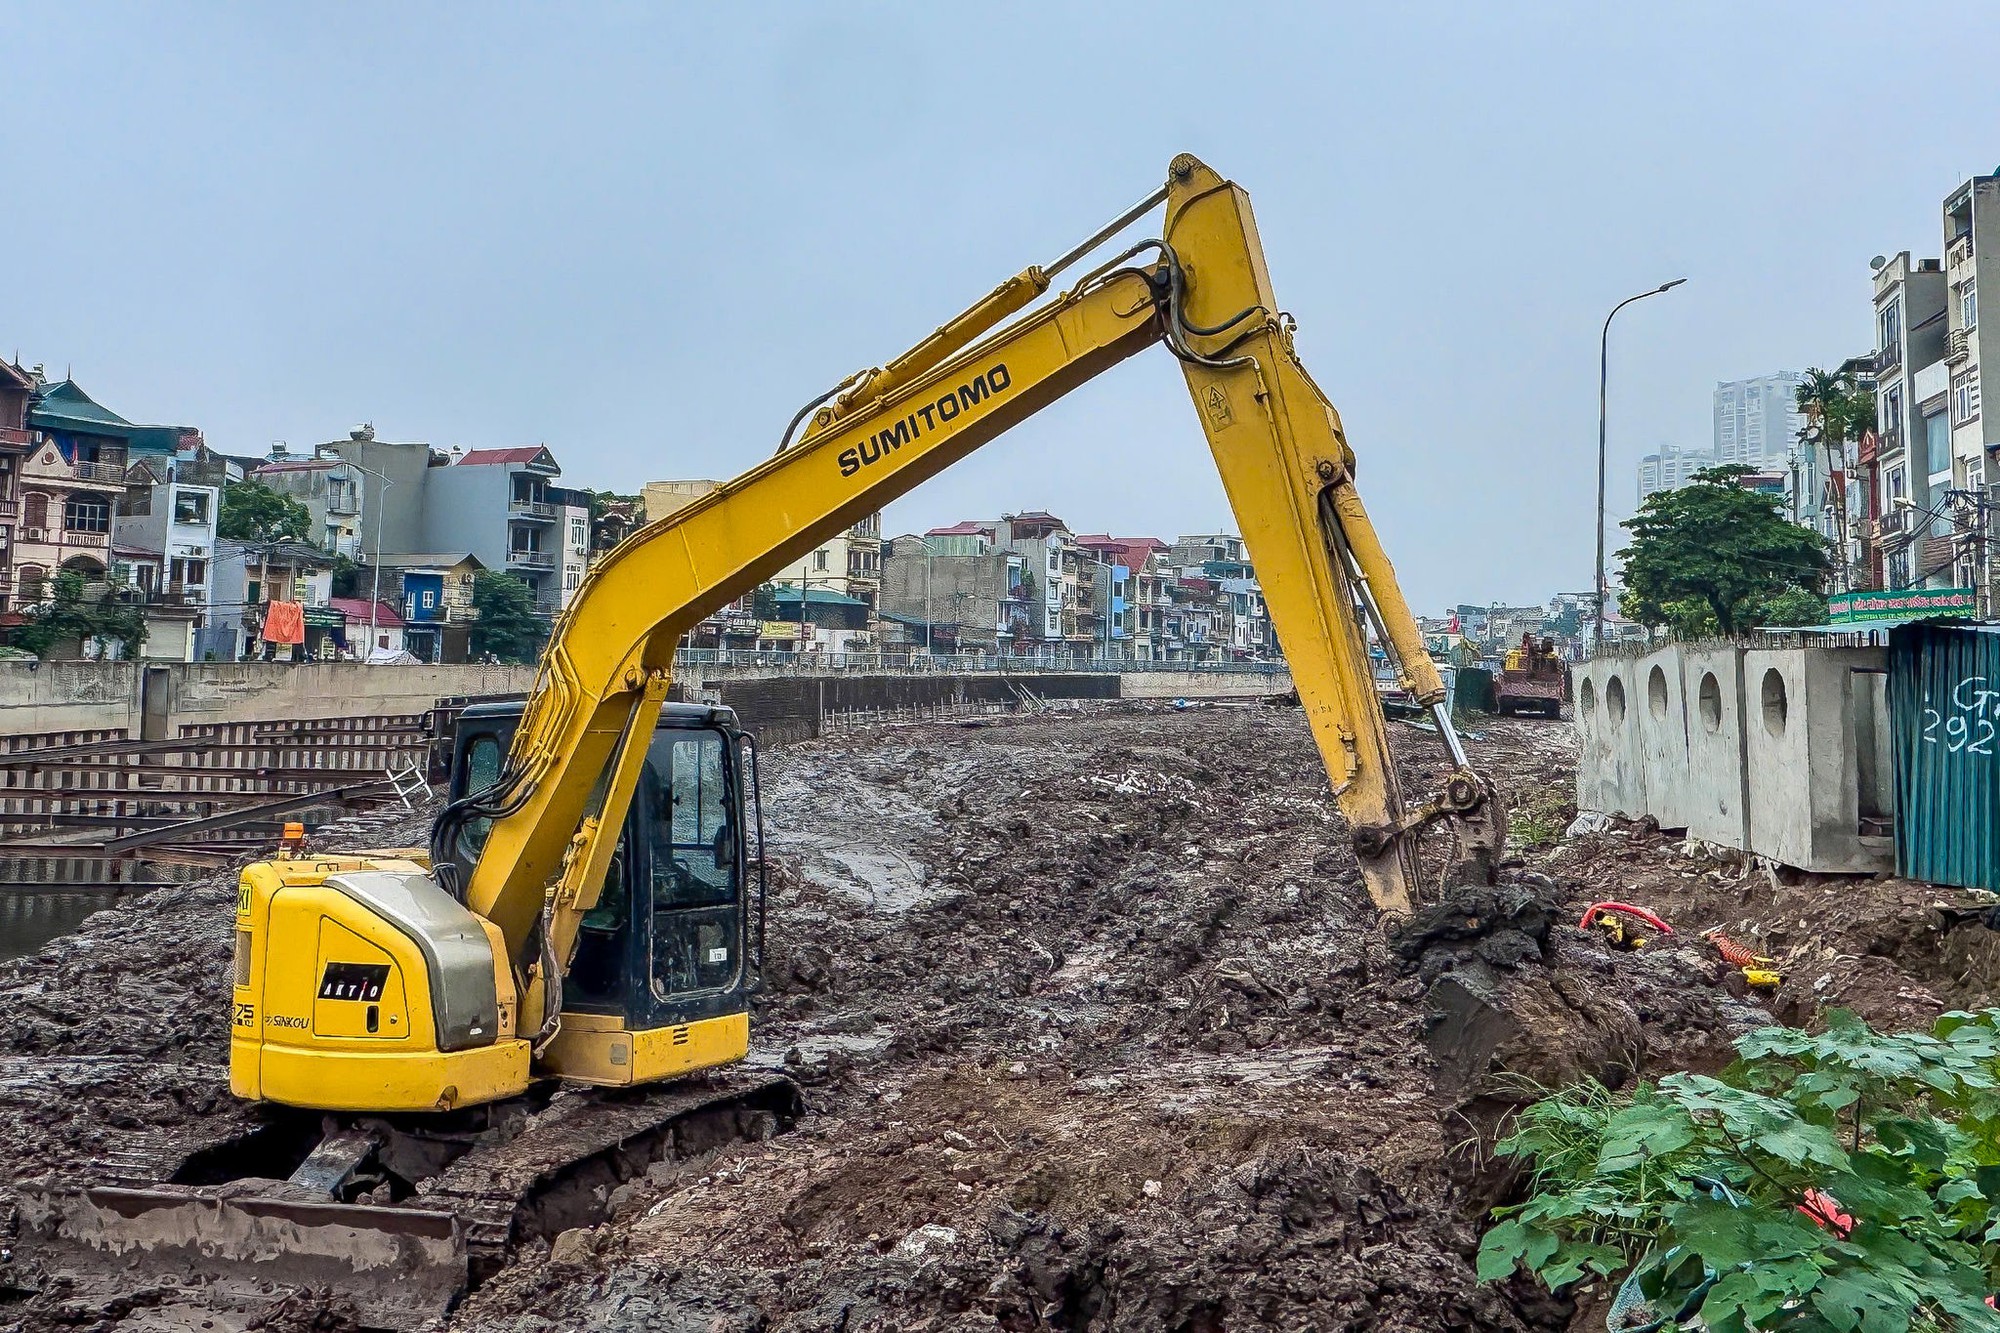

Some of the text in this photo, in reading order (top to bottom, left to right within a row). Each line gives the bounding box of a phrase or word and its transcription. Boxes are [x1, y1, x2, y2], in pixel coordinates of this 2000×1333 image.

[837, 363, 1012, 478] SUMITOMO
[1923, 708, 1994, 755] 292
[323, 981, 379, 1001] AKTIO
